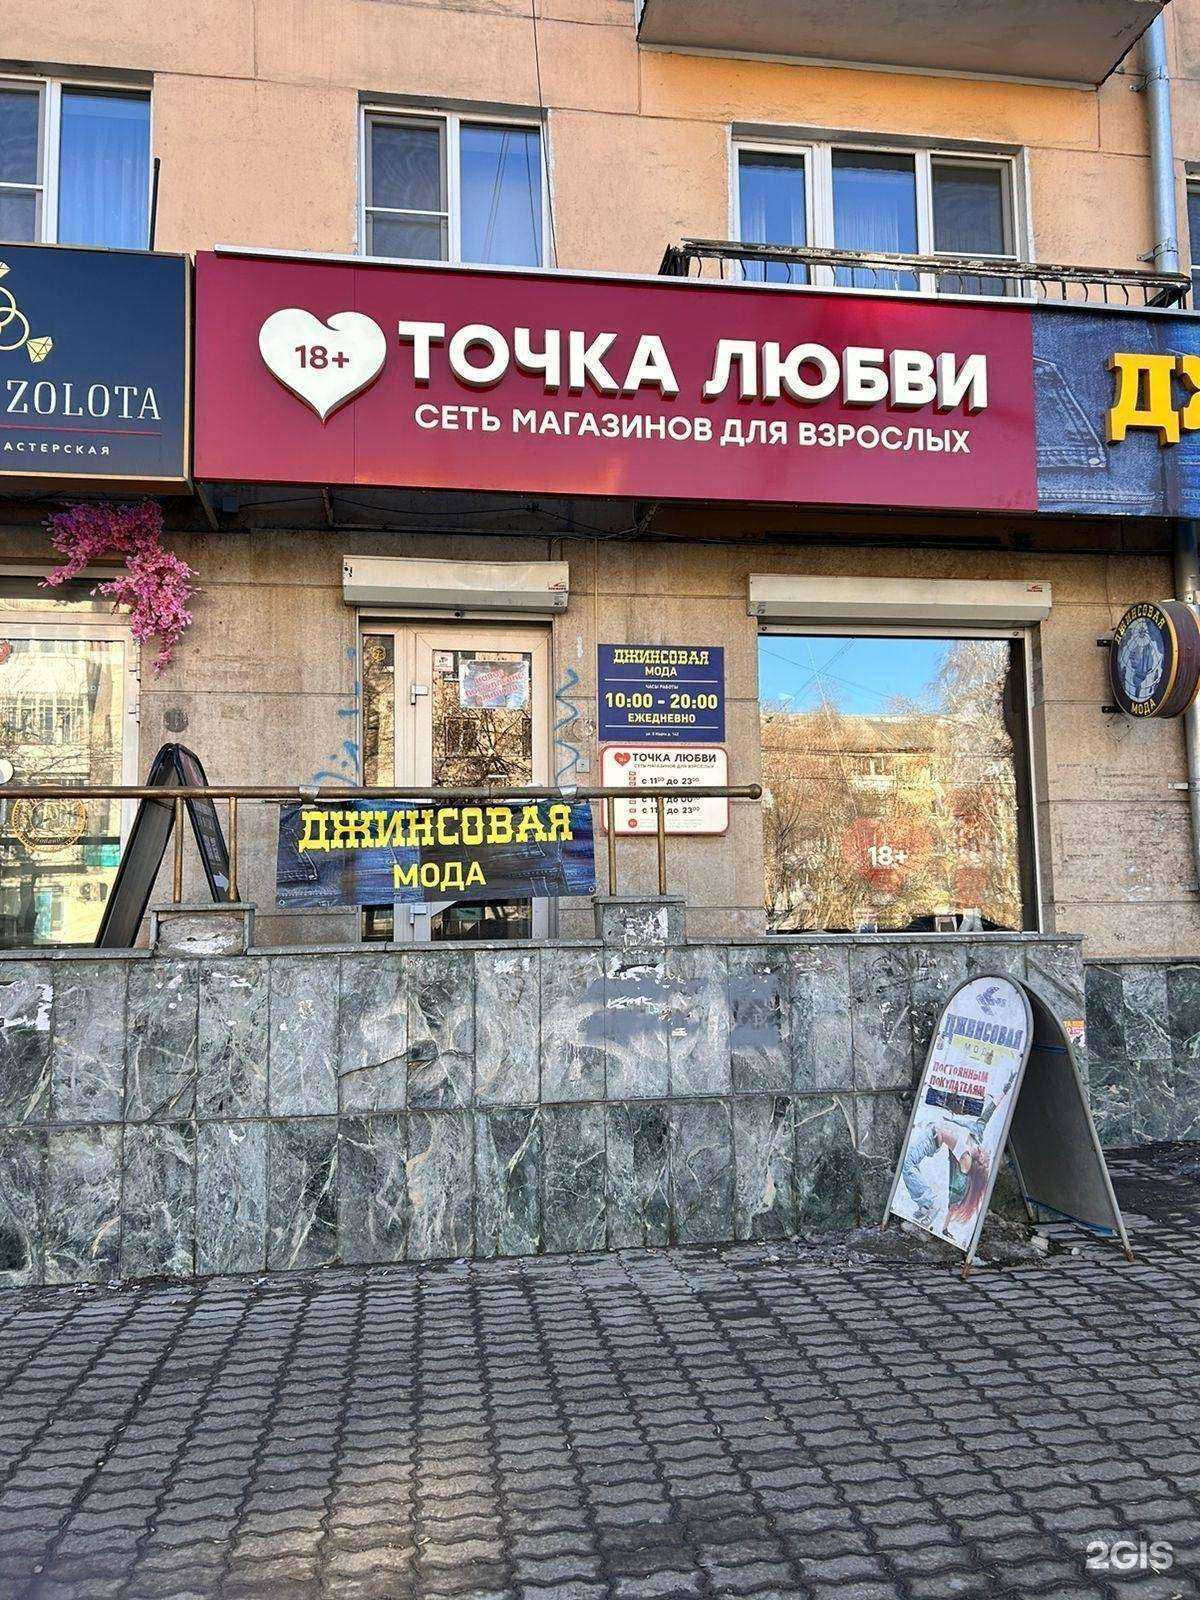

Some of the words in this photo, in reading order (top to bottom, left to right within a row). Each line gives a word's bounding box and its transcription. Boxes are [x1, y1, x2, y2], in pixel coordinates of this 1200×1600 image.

[294, 344, 350, 369] 18+
[398, 320, 680, 397] ТОЧКА
[703, 338, 989, 412] ЛЮБВИ
[6, 379, 162, 421] ZOLOTA
[414, 403, 501, 431] СЕТЬ
[512, 407, 713, 442] МАГАЗИНОВ
[720, 418, 788, 448] ДЛЯ
[798, 421, 971, 454] ВЗРОСЛЫХ
[613, 648, 710, 666] ДЖИНСОВАЯ
[645, 666, 678, 678] МОДА
[605, 692, 653, 708] 10:00
[669, 693, 718, 709] 20:00
[1130, 699, 1157, 716] МОДА
[627, 713, 696, 724] ЕЖЕДНЕВНО
[632, 753, 671, 762] ТОЧКА
[674, 753, 717, 763] ЛЮБВИ
[666, 778, 679, 786] до
[667, 807, 679, 815] до
[298, 804, 574, 853] ДЖИНСОВАЯ
[867, 844, 909, 868] 18+
[392, 860, 488, 892] МОДА
[932, 1061, 989, 1083] ПОСТОЯННЫМ
[929, 1074, 987, 1098] ПОКУПАТЕЛЯМ
